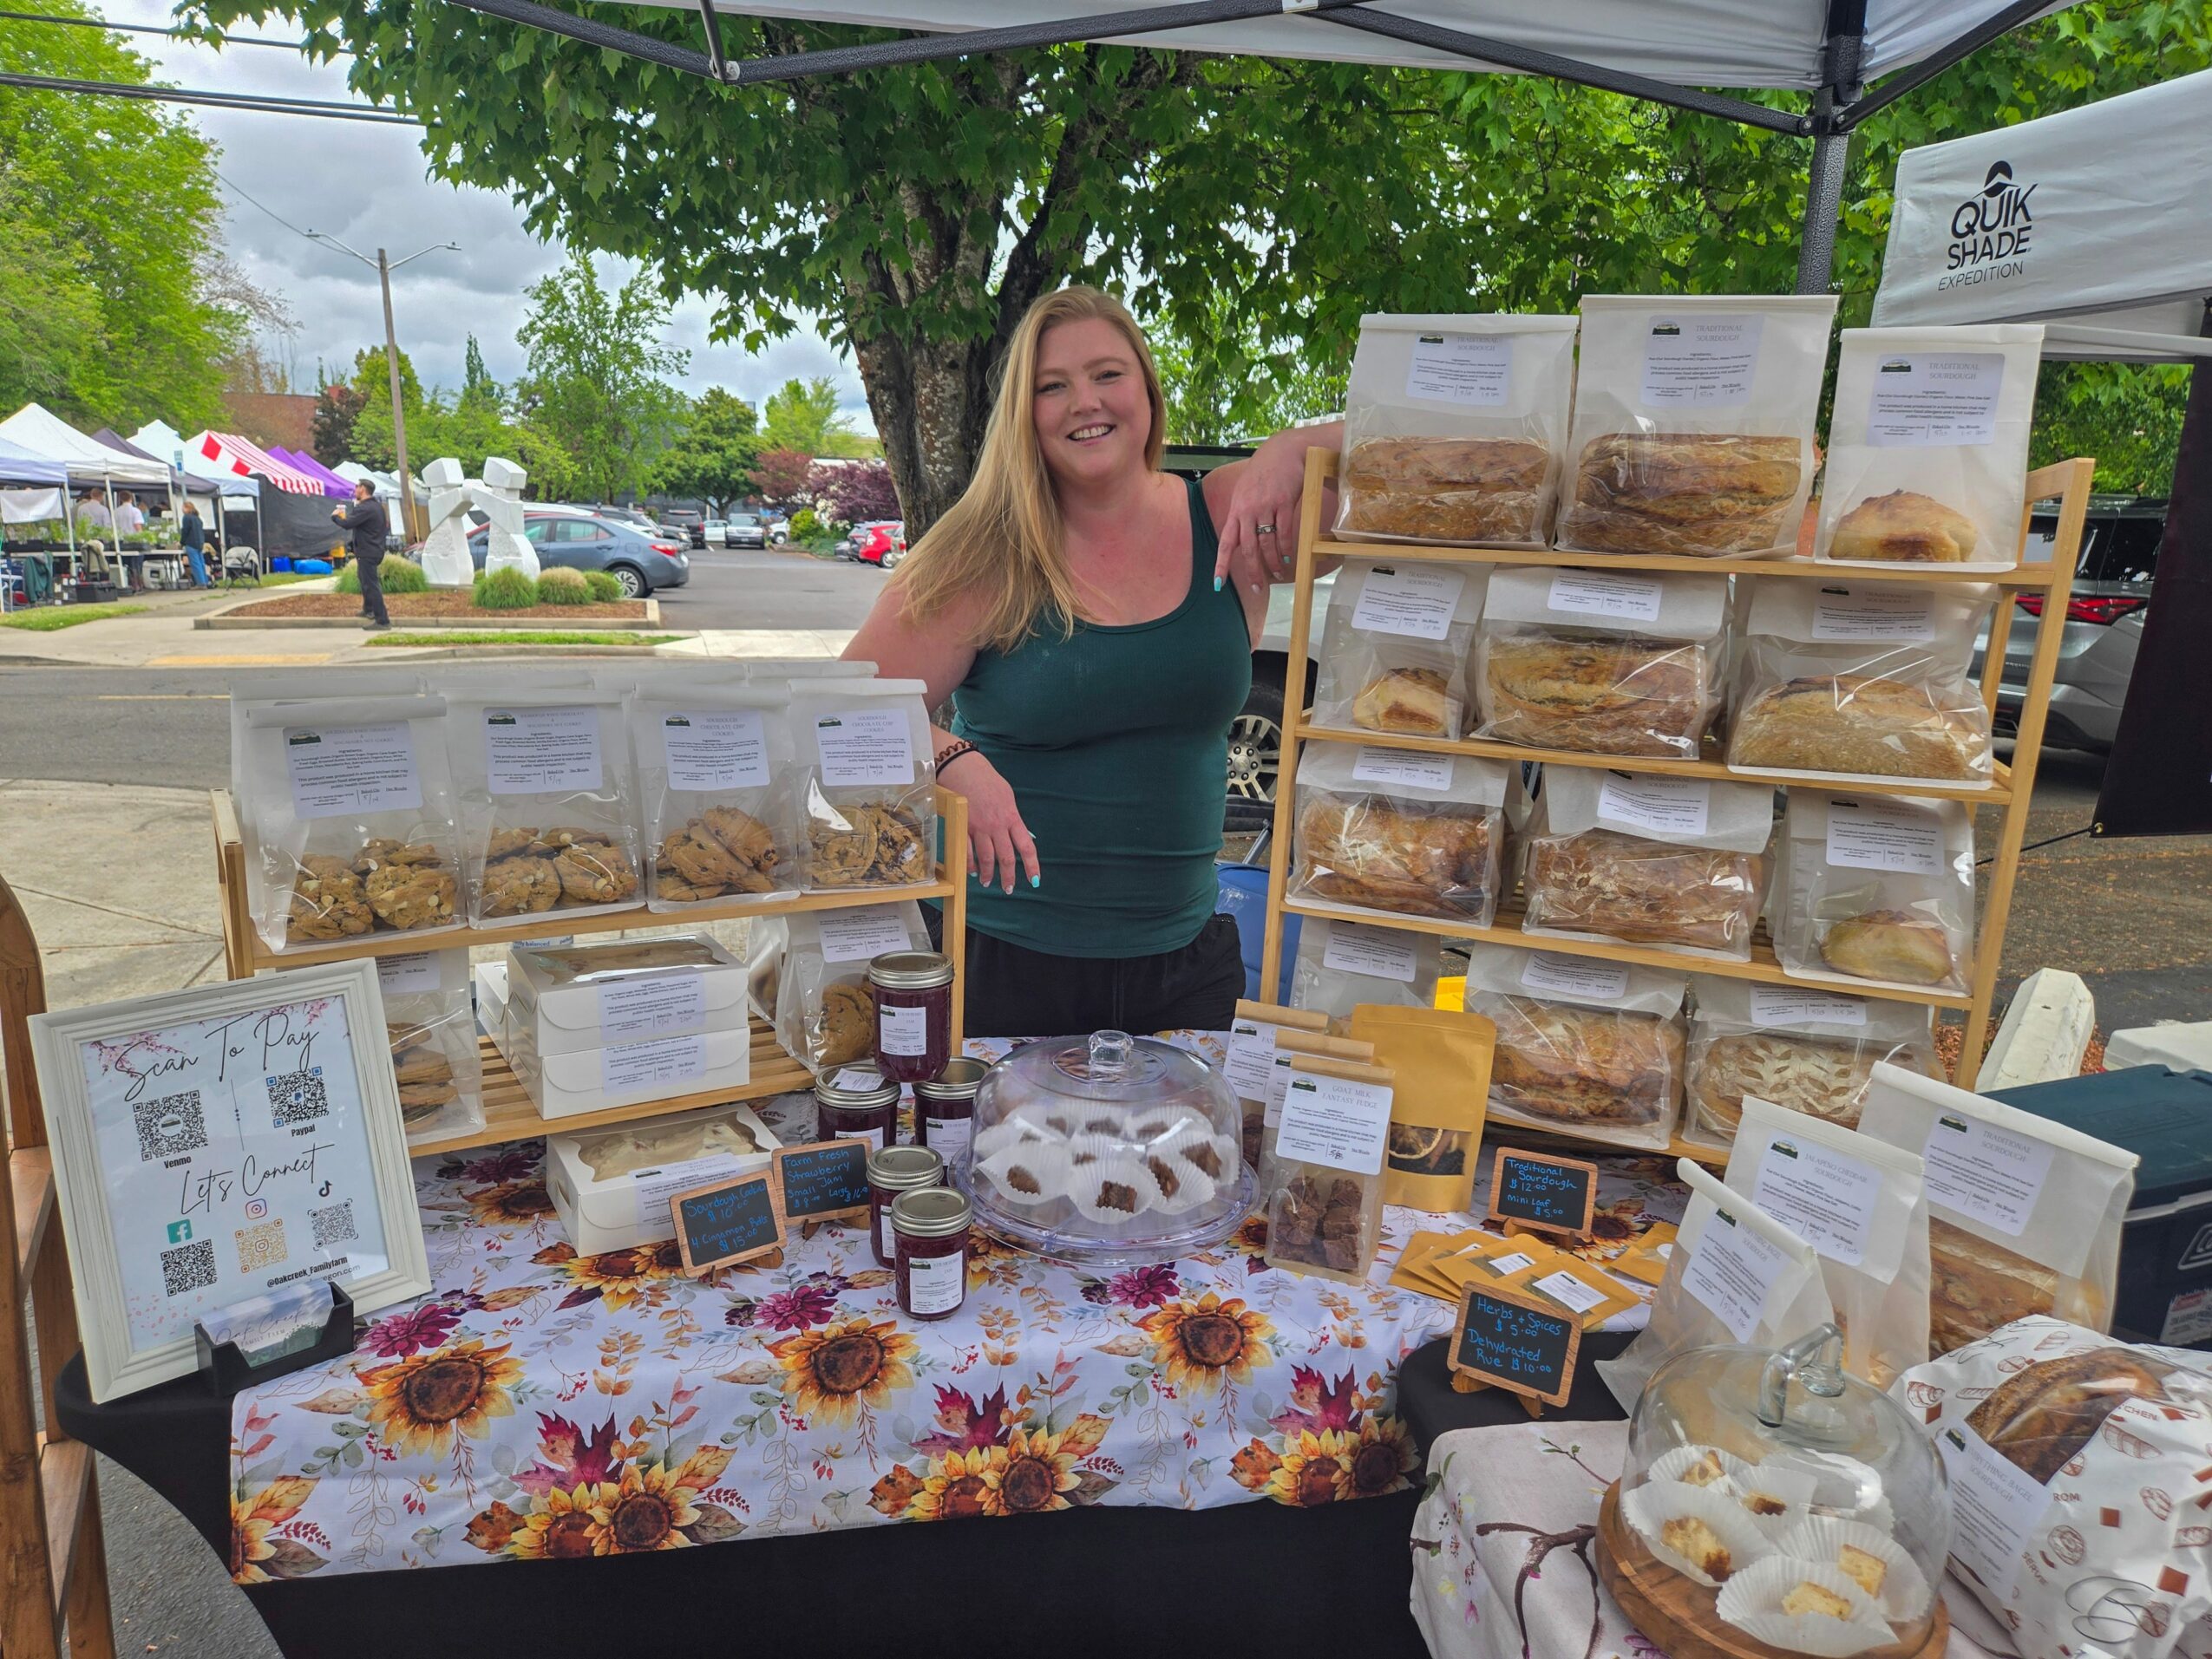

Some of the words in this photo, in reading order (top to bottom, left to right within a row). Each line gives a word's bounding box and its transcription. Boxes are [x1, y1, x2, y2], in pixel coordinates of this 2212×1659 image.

[1951, 183, 2039, 239] QUIK
[1947, 225, 2032, 271] SHADE
[1938, 261, 2024, 291] EXPEDITION
[115, 1041, 199, 1102] Scan
[204, 1011, 254, 1082] To
[253, 1012, 319, 1073] Pay
[291, 1125, 316, 1138] Paypal
[1982, 1129, 2033, 1154] TRADITIONAL
[163, 1155, 192, 1170] Venmo
[783, 1155, 813, 1168] Farm
[818, 1149, 849, 1160] Fresh
[1980, 1140, 2027, 1163] SOURDOUGH
[180, 1169, 233, 1215] Let's
[242, 1142, 336, 1197] Connect
[787, 1162, 850, 1183] Strawberry
[1505, 1158, 1563, 1177] Traditional
[816, 1175, 843, 1187] Jam
[1518, 1170, 1578, 1191] Sourdough
[787, 1185, 815, 1199] Small
[684, 1192, 739, 1218] Sourdough
[701, 1225, 746, 1244] Cinnamon
[1477, 1297, 1514, 1319] Herbs
[1527, 1312, 1562, 1336] Spices
[1467, 1328, 1541, 1362] Dehydrated
[1476, 1348, 1503, 1368] Rue
